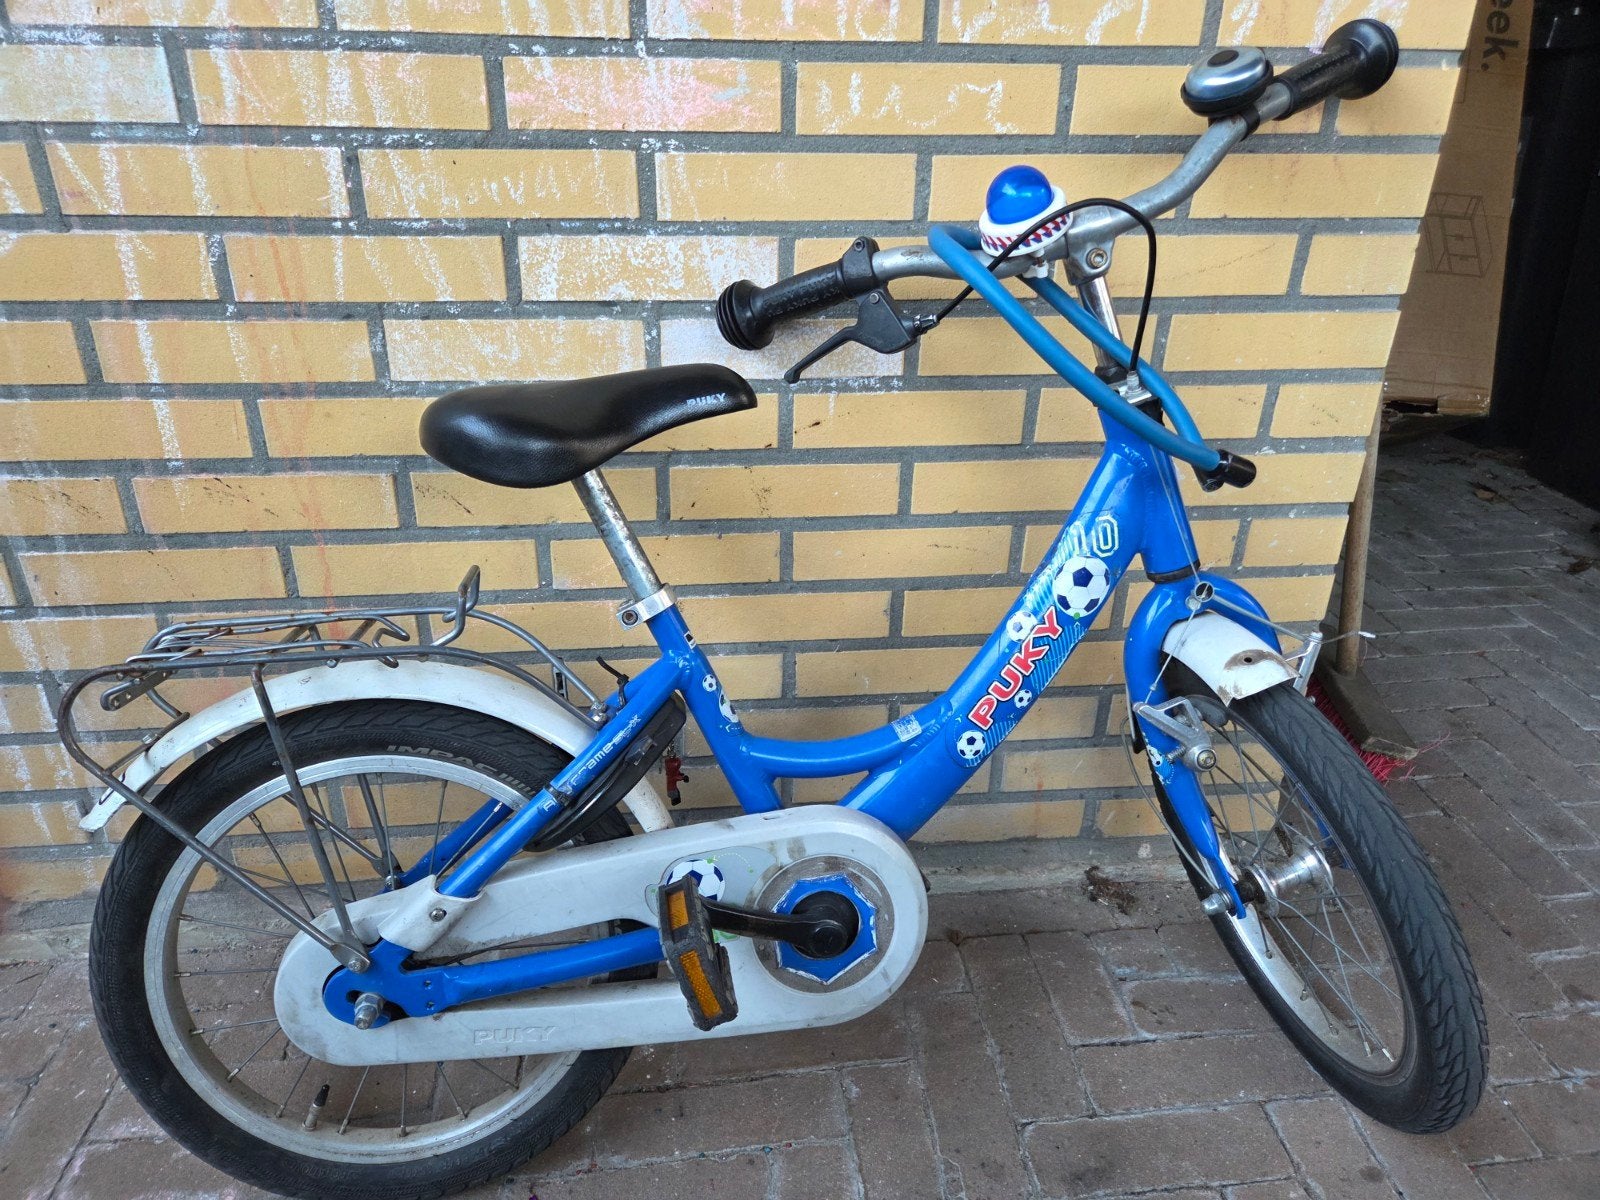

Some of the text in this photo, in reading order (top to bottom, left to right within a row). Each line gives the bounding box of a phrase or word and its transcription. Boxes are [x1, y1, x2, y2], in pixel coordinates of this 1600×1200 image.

[686, 392, 726, 407] PUKY
[967, 605, 1063, 730] PUKY
[473, 1025, 559, 1046] PUKY
